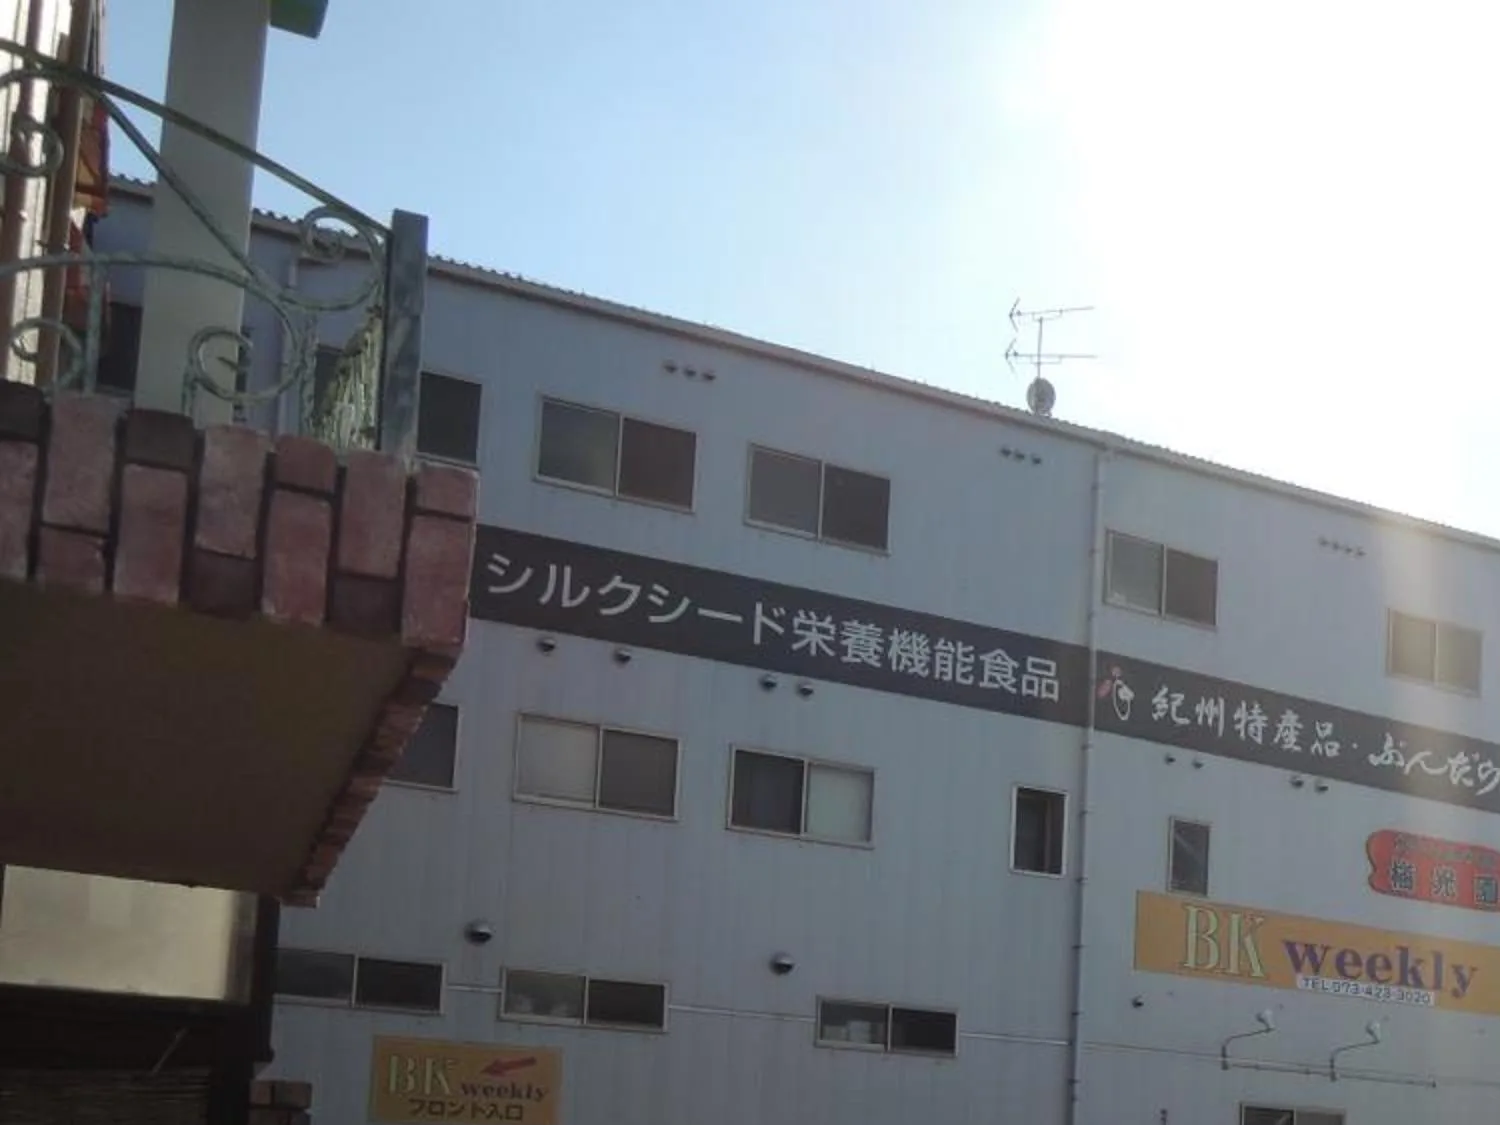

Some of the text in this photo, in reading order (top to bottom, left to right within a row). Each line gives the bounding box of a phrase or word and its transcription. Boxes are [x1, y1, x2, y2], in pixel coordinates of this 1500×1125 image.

[486, 552, 1060, 702] シルクシード栄養機能食品
[1184, 902, 1478, 999] BK weekly
[389, 1054, 549, 1102] BK weekly
[409, 1098, 524, 1121] フロント入口
